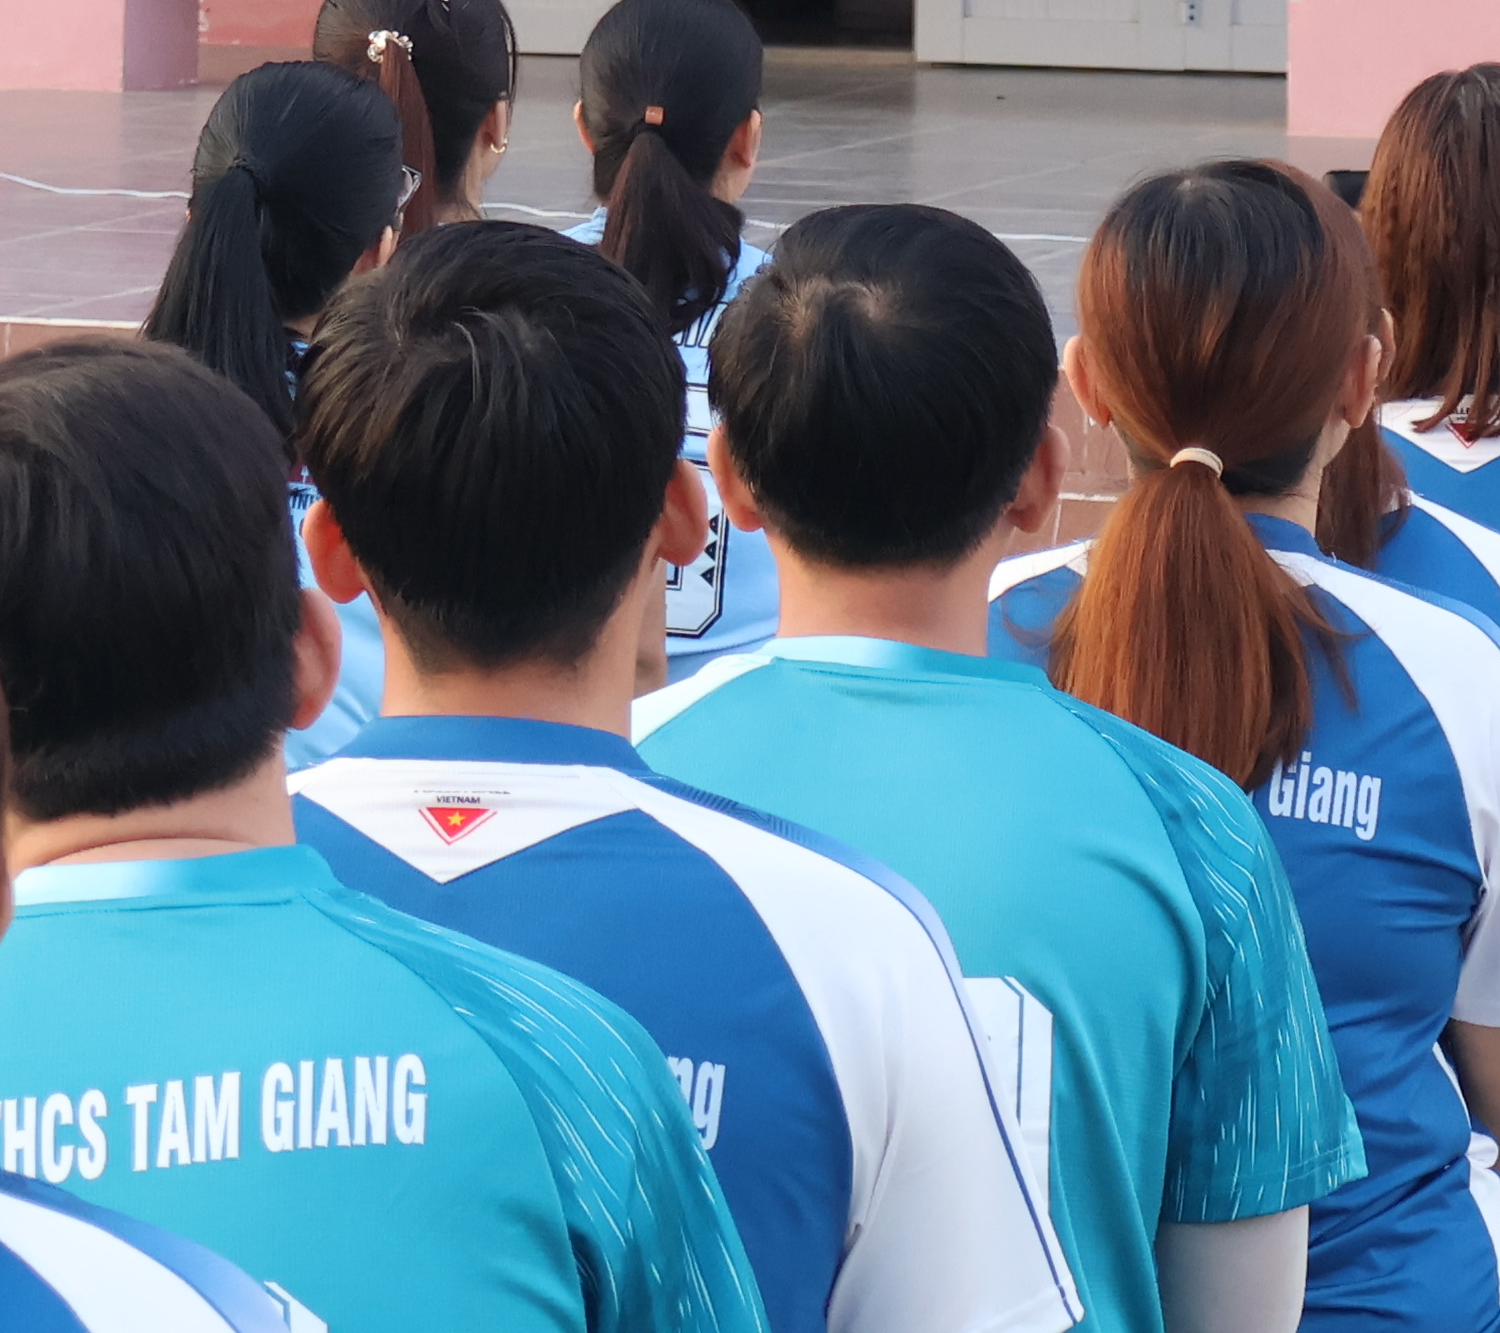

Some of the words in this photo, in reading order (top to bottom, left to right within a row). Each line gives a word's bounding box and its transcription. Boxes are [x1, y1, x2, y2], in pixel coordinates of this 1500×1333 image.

[436, 796, 481, 804] VIETNAM
[1268, 750, 1382, 841] Giang
[125, 1071, 242, 1172] TAM
[261, 1053, 428, 1153] GIANG
